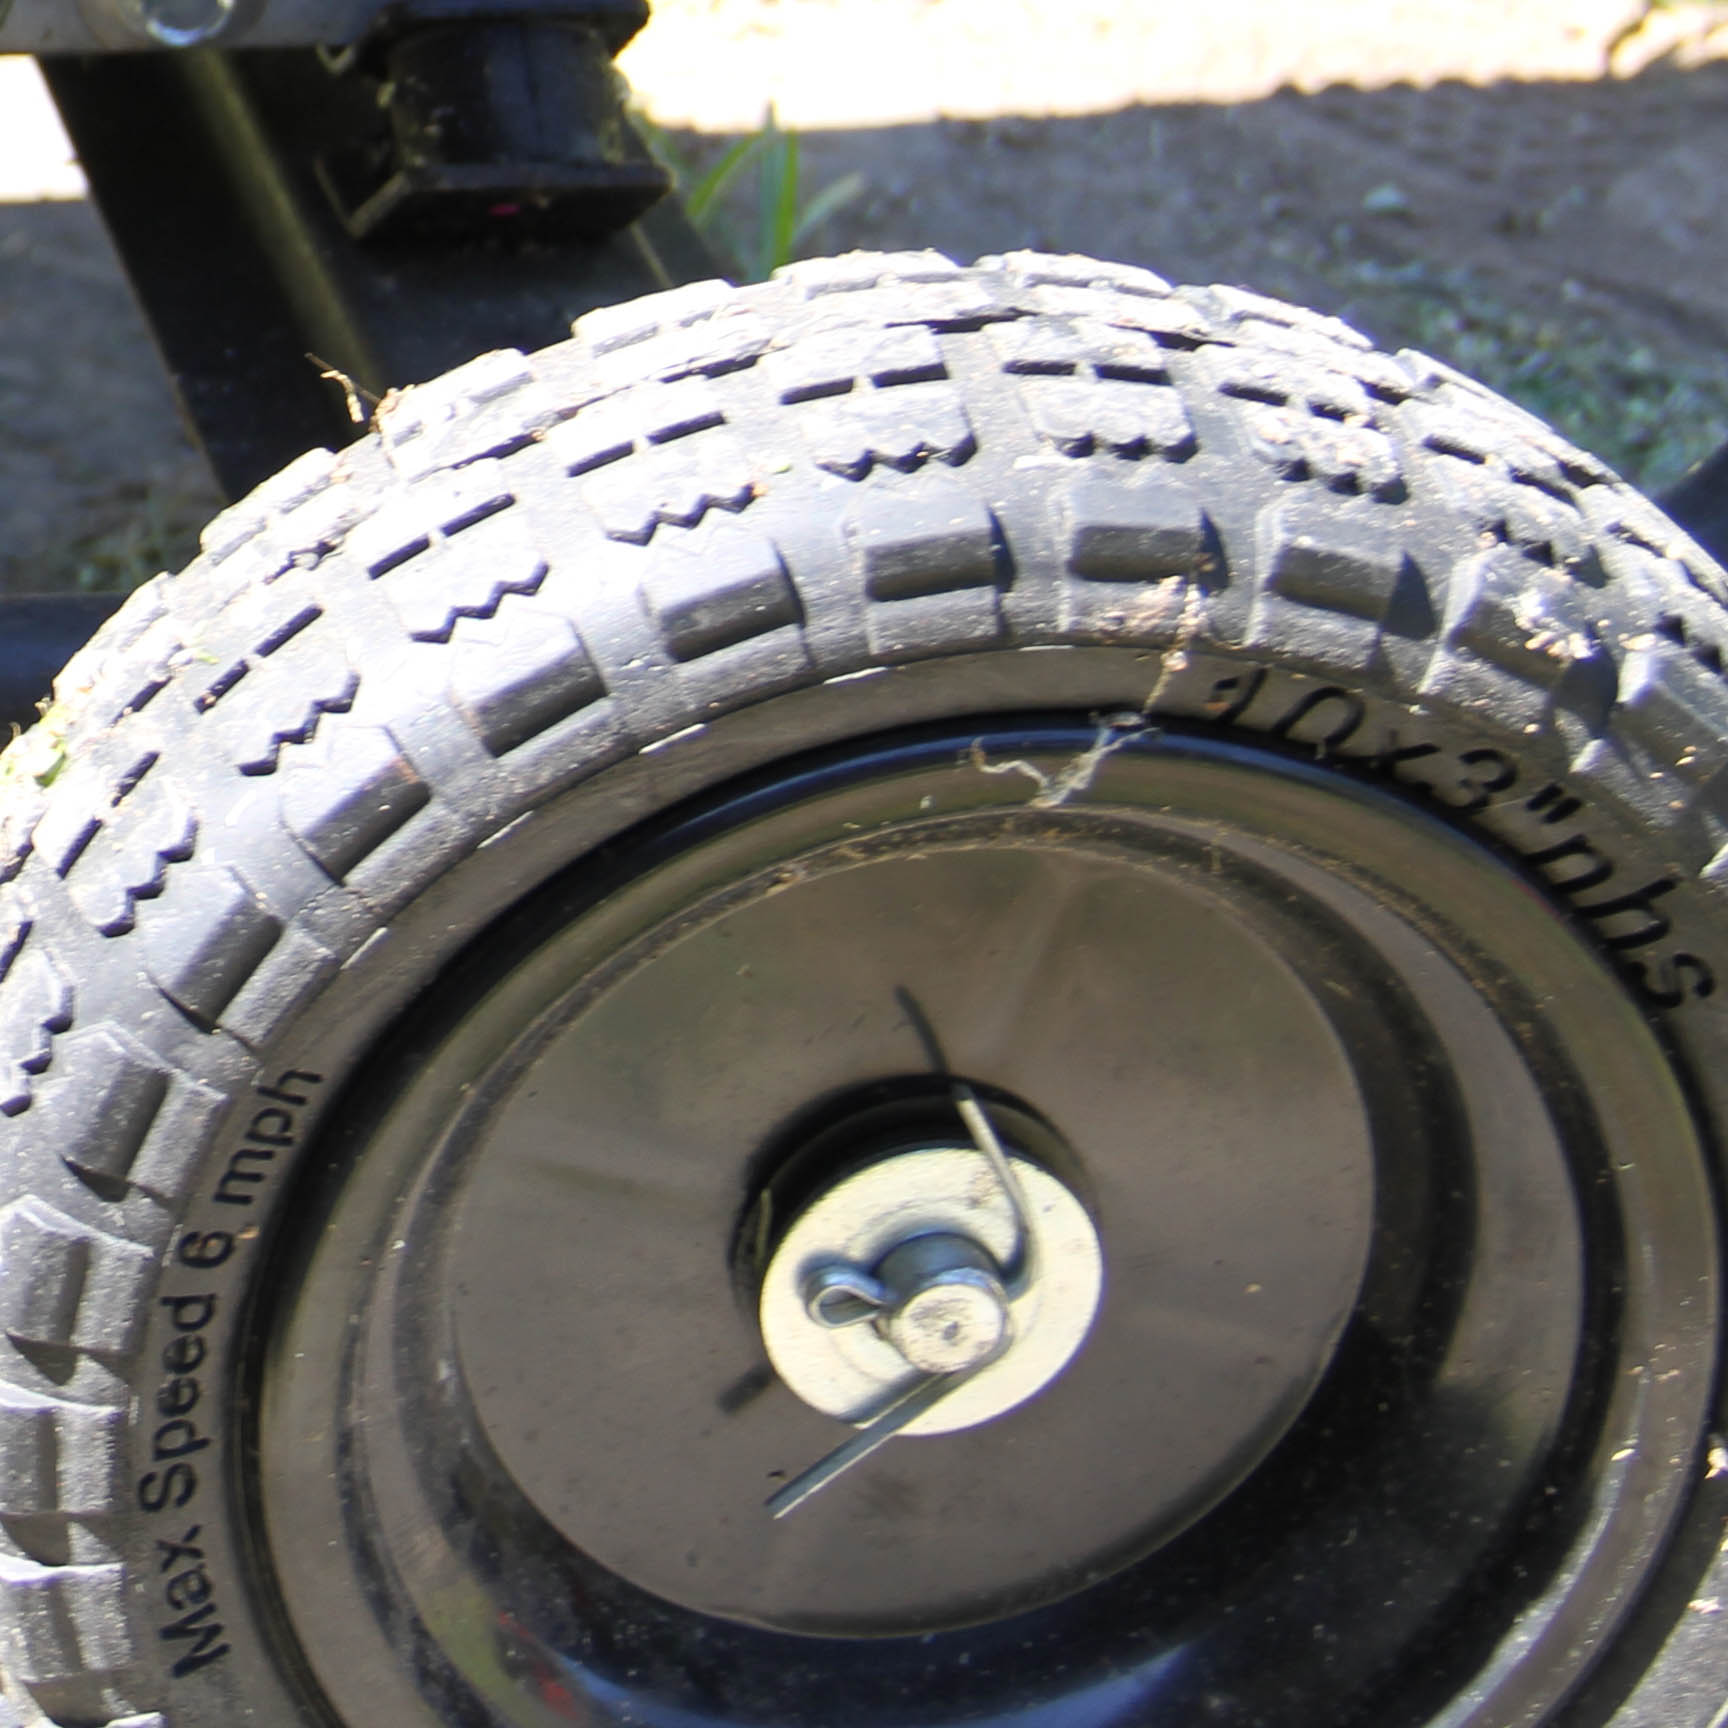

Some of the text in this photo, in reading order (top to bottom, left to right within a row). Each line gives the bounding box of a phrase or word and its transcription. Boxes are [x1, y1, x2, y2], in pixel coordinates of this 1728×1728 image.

[136, 1068, 326, 1679] Max Speed 6 mph
